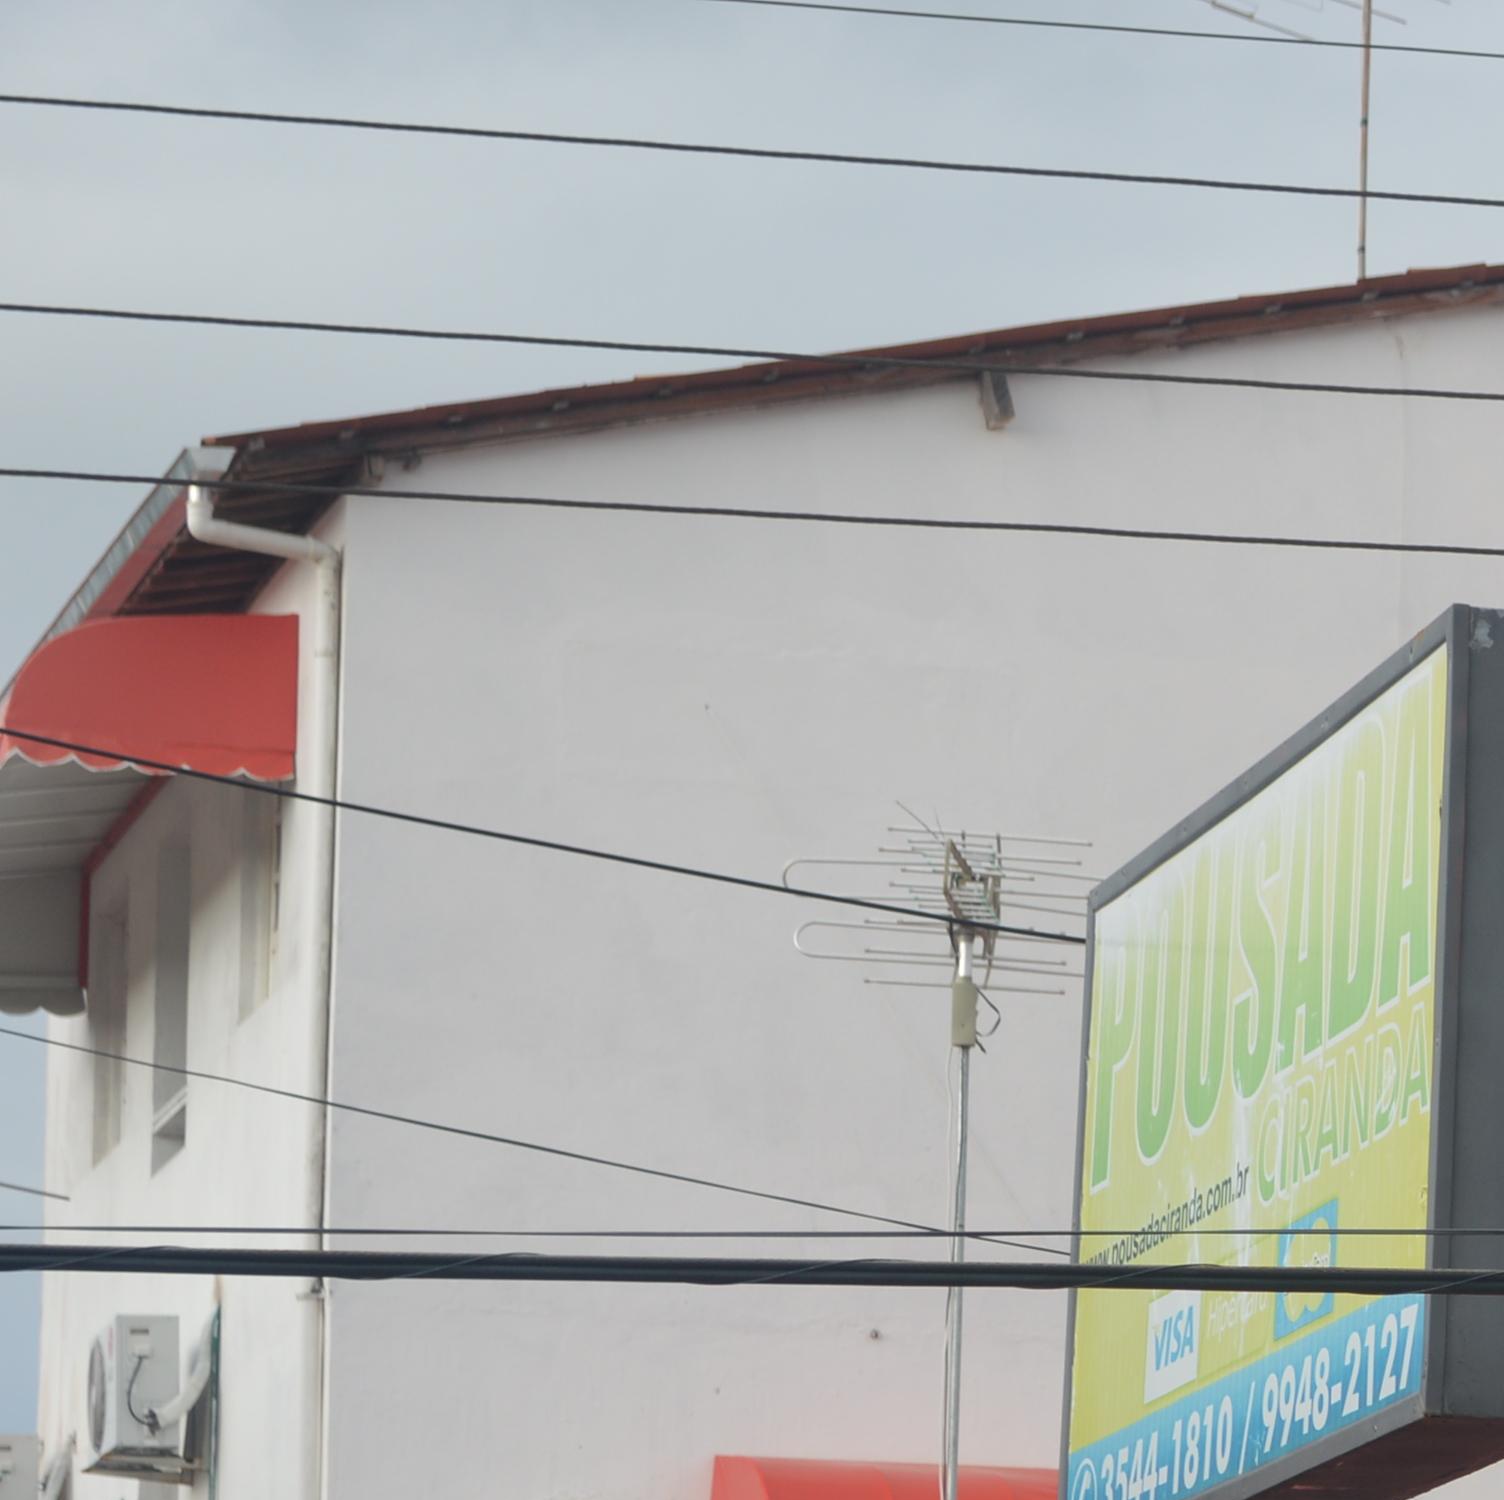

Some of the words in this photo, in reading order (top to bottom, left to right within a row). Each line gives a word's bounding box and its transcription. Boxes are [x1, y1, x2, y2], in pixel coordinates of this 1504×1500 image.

[1090, 670, 1431, 1194] POUSADA
[1256, 1001, 1429, 1206] CIRANDA
[1084, 1162, 1249, 1266] wpousadaciranda.com.br
[1153, 1304, 1194, 1372] VISA
[1262, 1303, 1419, 1454] 9948-2127
